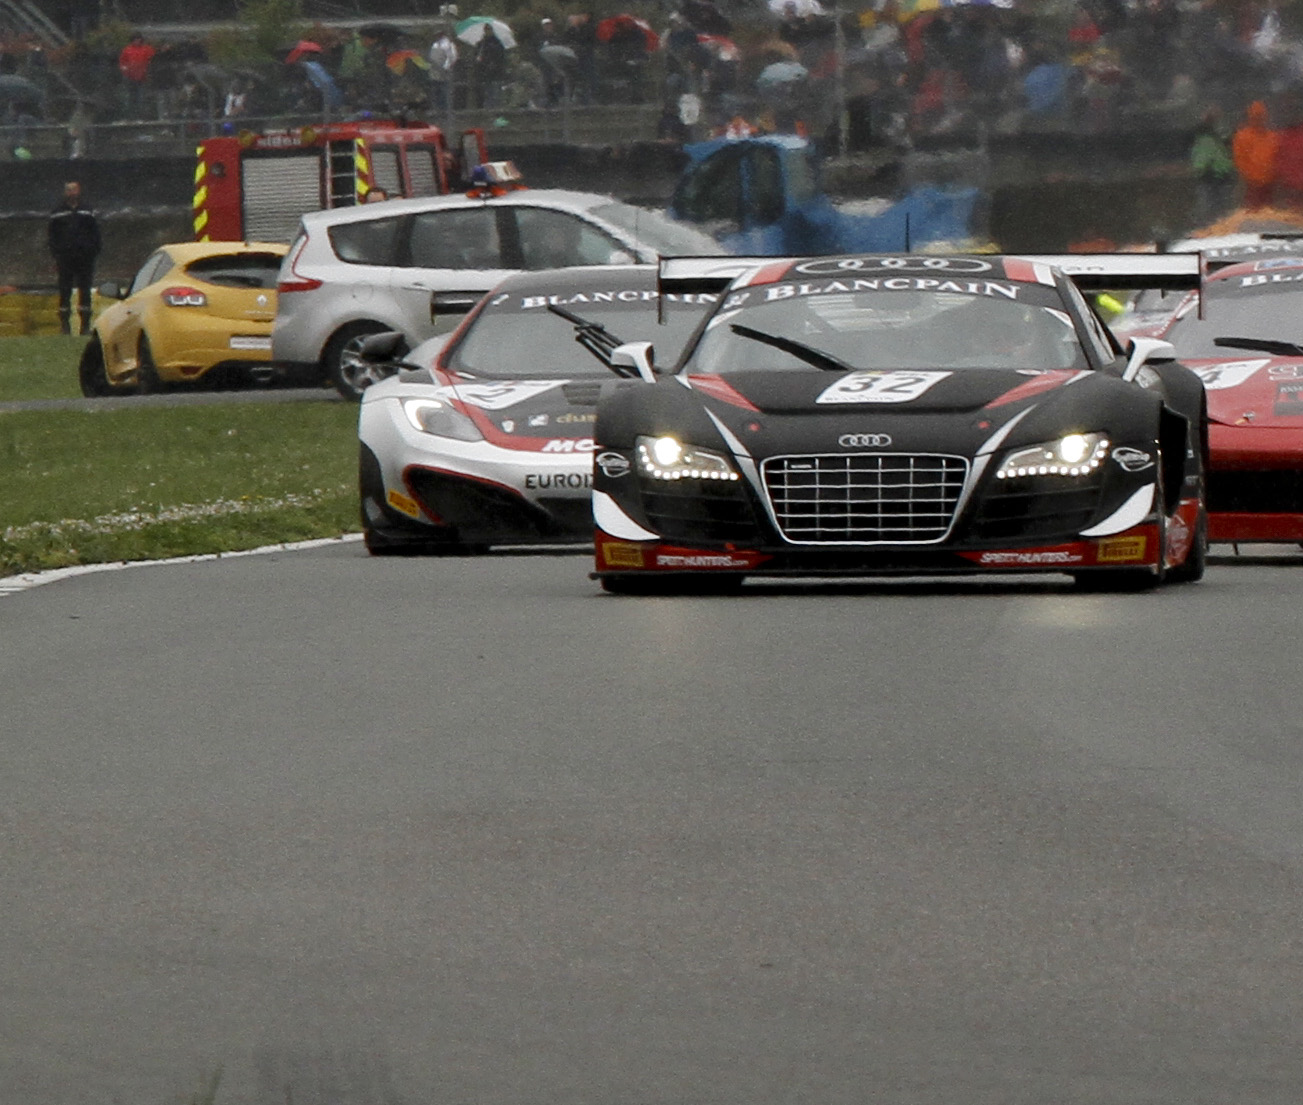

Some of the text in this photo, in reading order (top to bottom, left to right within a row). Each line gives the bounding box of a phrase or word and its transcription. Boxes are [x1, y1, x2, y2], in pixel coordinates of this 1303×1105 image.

[765, 276, 1020, 302] BLANCPAIN
[521, 290, 719, 309] BLANCPAIN
[838, 376, 926, 394] 32
